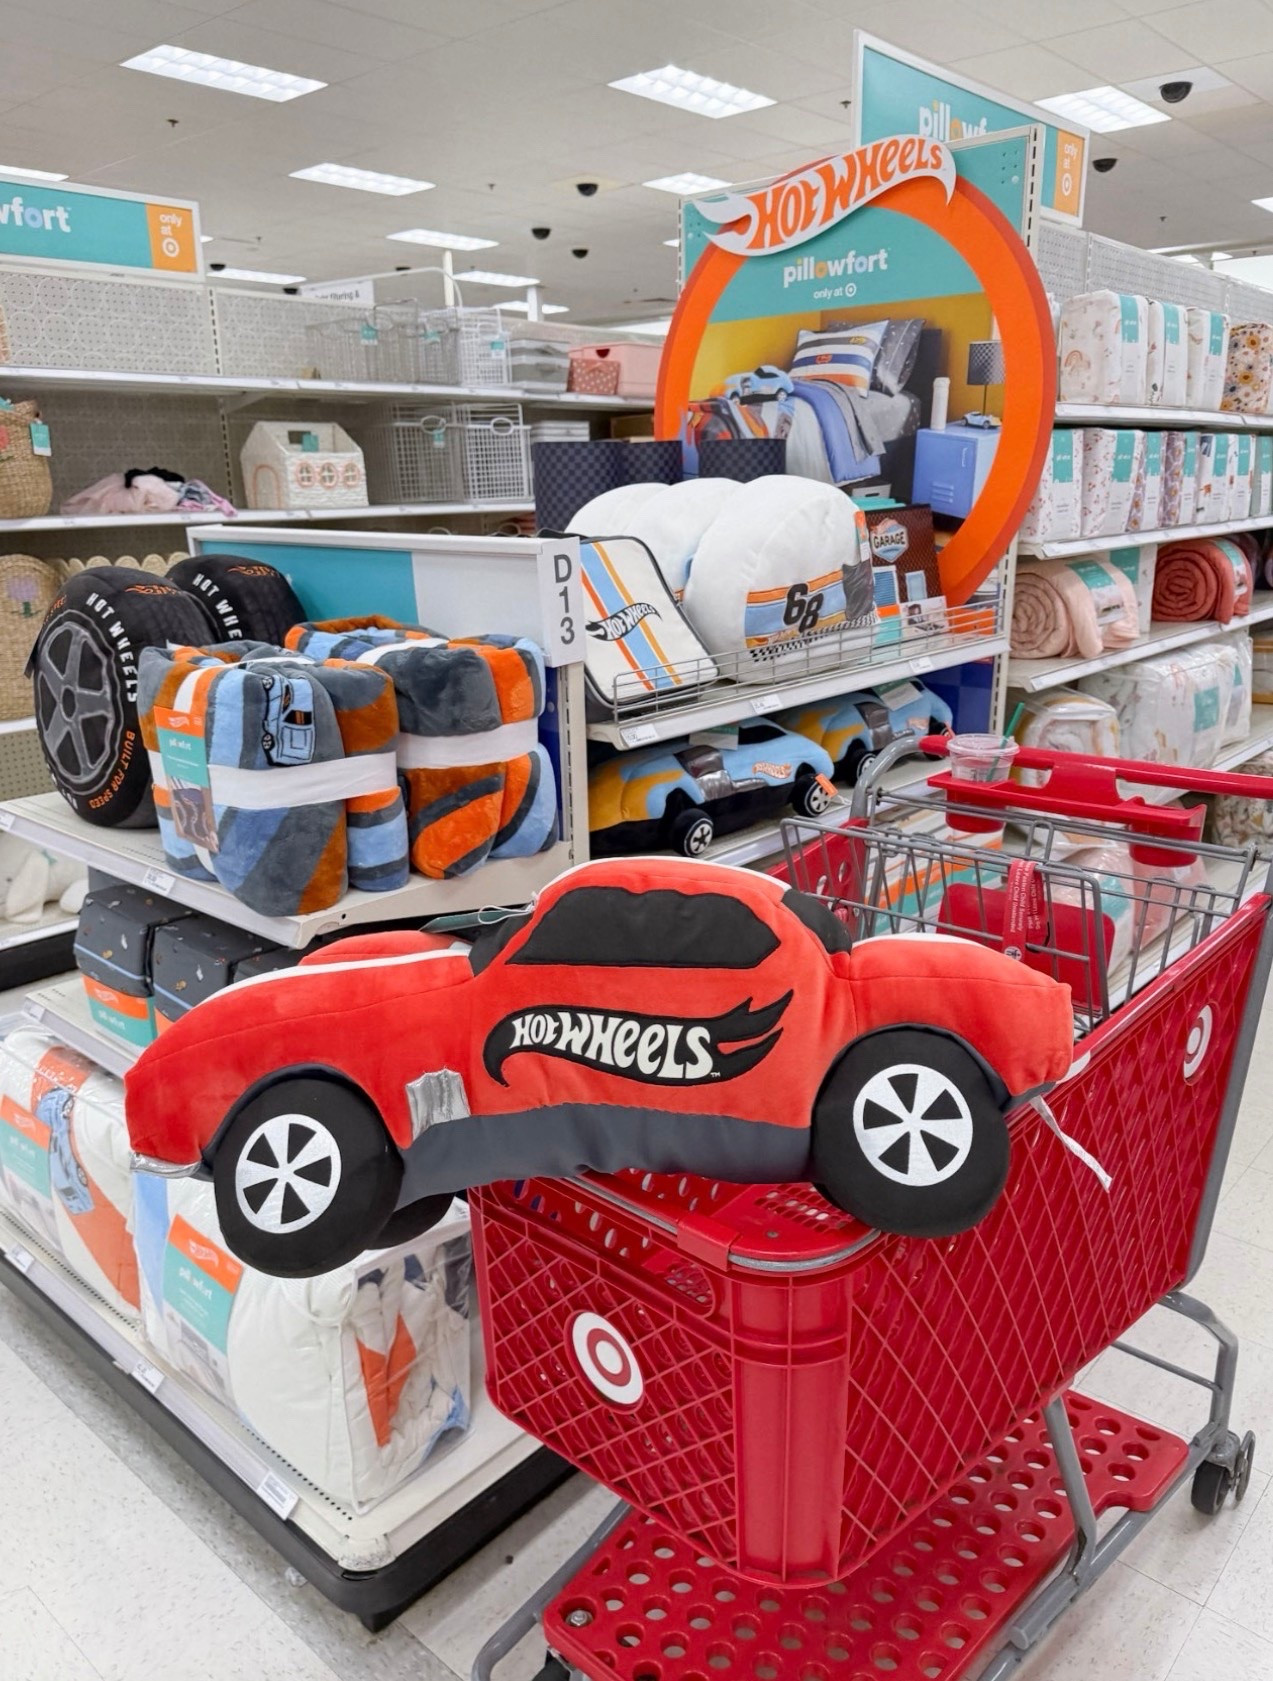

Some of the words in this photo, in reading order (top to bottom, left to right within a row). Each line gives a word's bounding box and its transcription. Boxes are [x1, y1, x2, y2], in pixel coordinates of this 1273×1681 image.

[160, 213, 182, 228] only
[746, 180, 820, 249] HOT
[161, 225, 173, 236] at
[783, 249, 888, 288] pillowfort
[813, 288, 833, 300] only
[833, 287, 843, 297] at
[873, 532, 905, 548] GARAGE
[192, 573, 219, 597] HOT
[783, 583, 824, 633] 68
[86, 592, 115, 619] HOT
[108, 621, 138, 702] WHEELS
[120, 730, 136, 770] BUILT
[111, 769, 125, 791] FOR
[88, 789, 113, 809] SPEED
[509, 1012, 559, 1050] HOT
